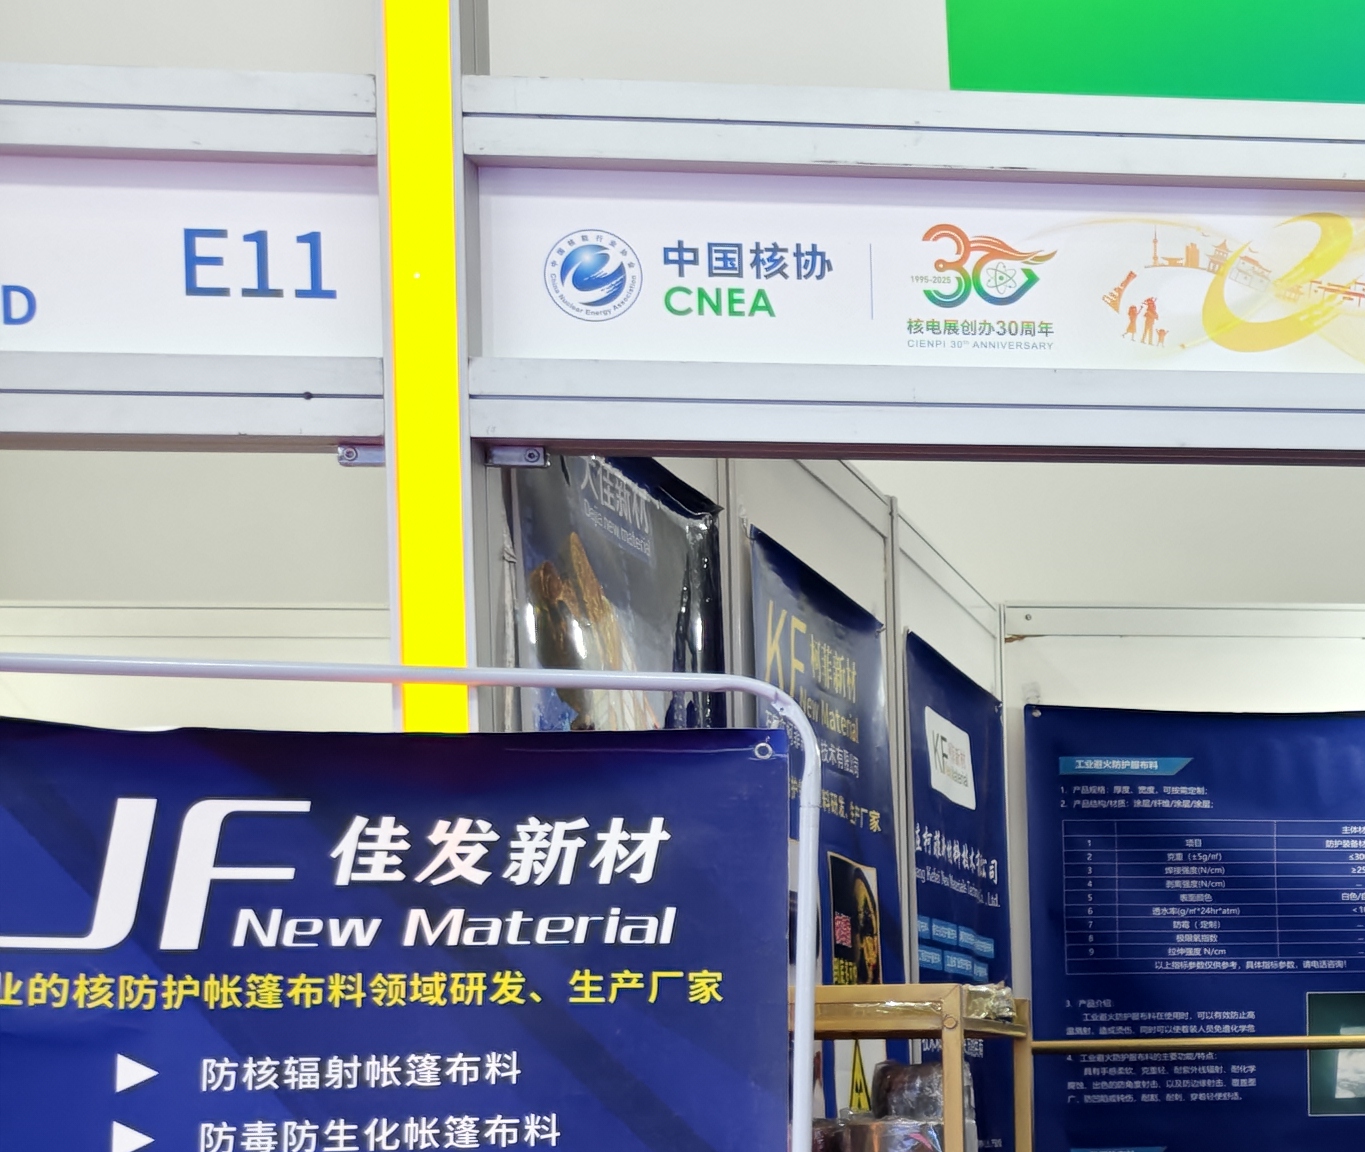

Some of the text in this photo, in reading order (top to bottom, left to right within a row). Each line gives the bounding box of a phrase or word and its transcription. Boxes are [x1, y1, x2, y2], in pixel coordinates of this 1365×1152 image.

[183, 227, 337, 300] E11
[663, 240, 834, 282] 中国核协
[910, 275, 952, 285] 1995-2025
[663, 285, 777, 318] CNEA
[906, 318, 1055, 337] 核电展创办30周年
[907, 339, 946, 349] CIENPI
[972, 340, 1054, 351] ANNIVERSARY
[764, 599, 808, 699] KF
[329, 814, 672, 887] 佳发新材
[230, 906, 678, 949] New Material
[200, 1050, 522, 1093] 防核辐射帐篷布料
